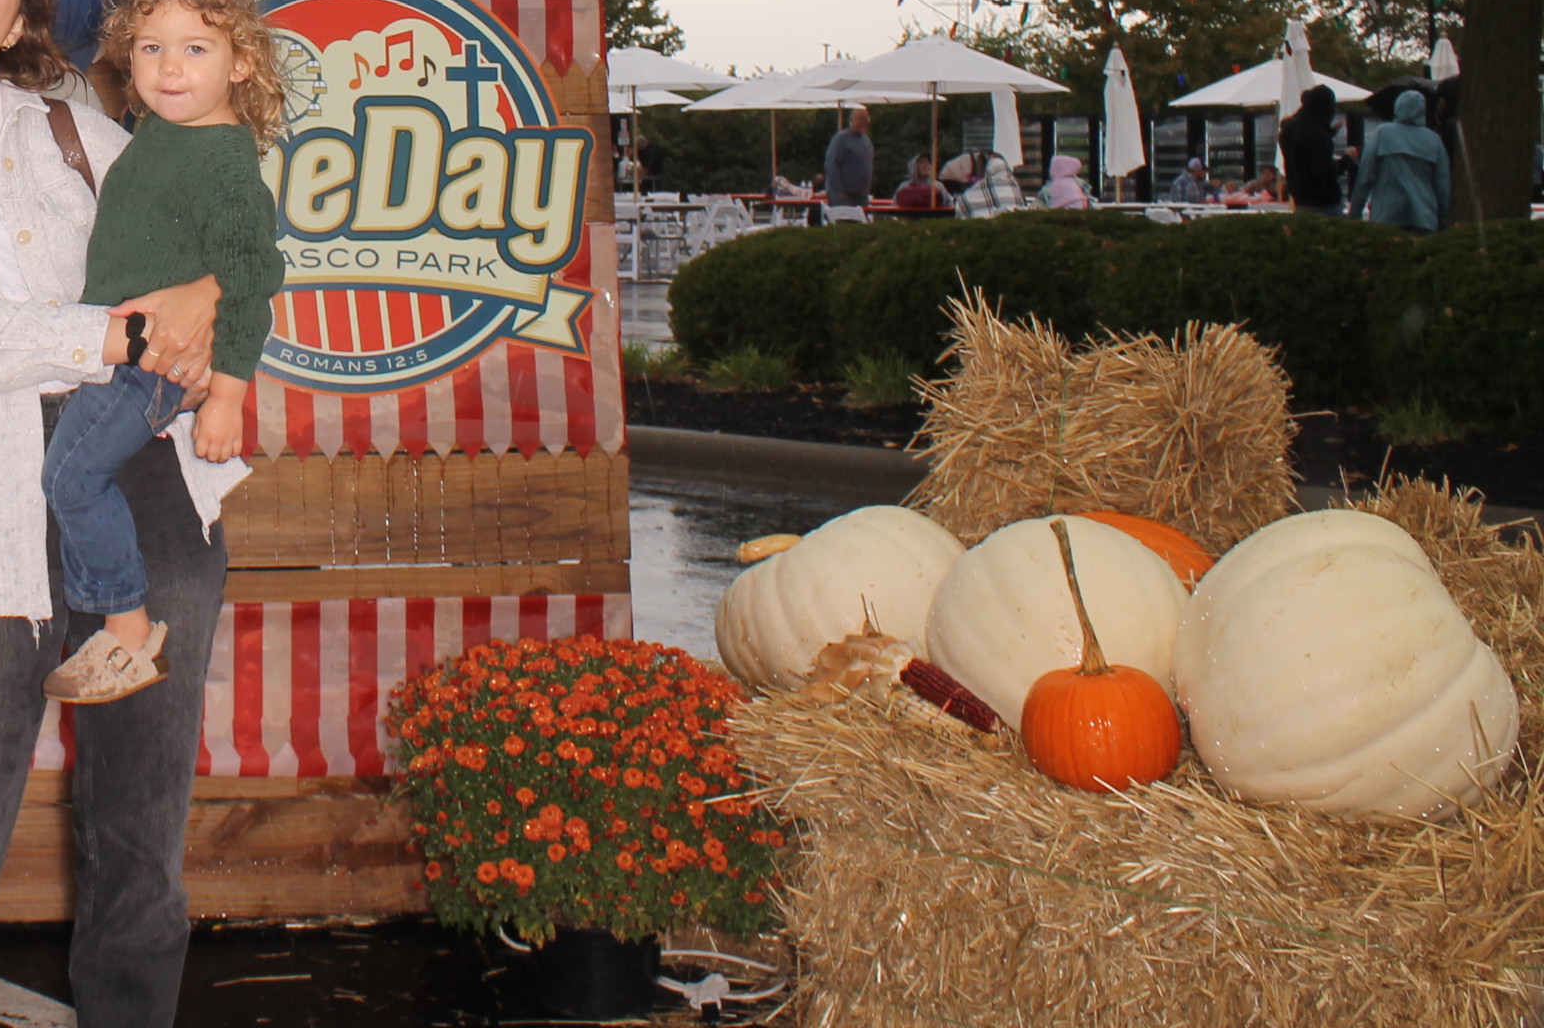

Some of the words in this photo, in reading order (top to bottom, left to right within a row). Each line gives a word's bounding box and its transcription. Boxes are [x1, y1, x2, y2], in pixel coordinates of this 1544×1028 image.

[397, 250, 498, 279] PARK
[279, 348, 377, 373] ROMANS
[386, 349, 428, 370] 12:5
